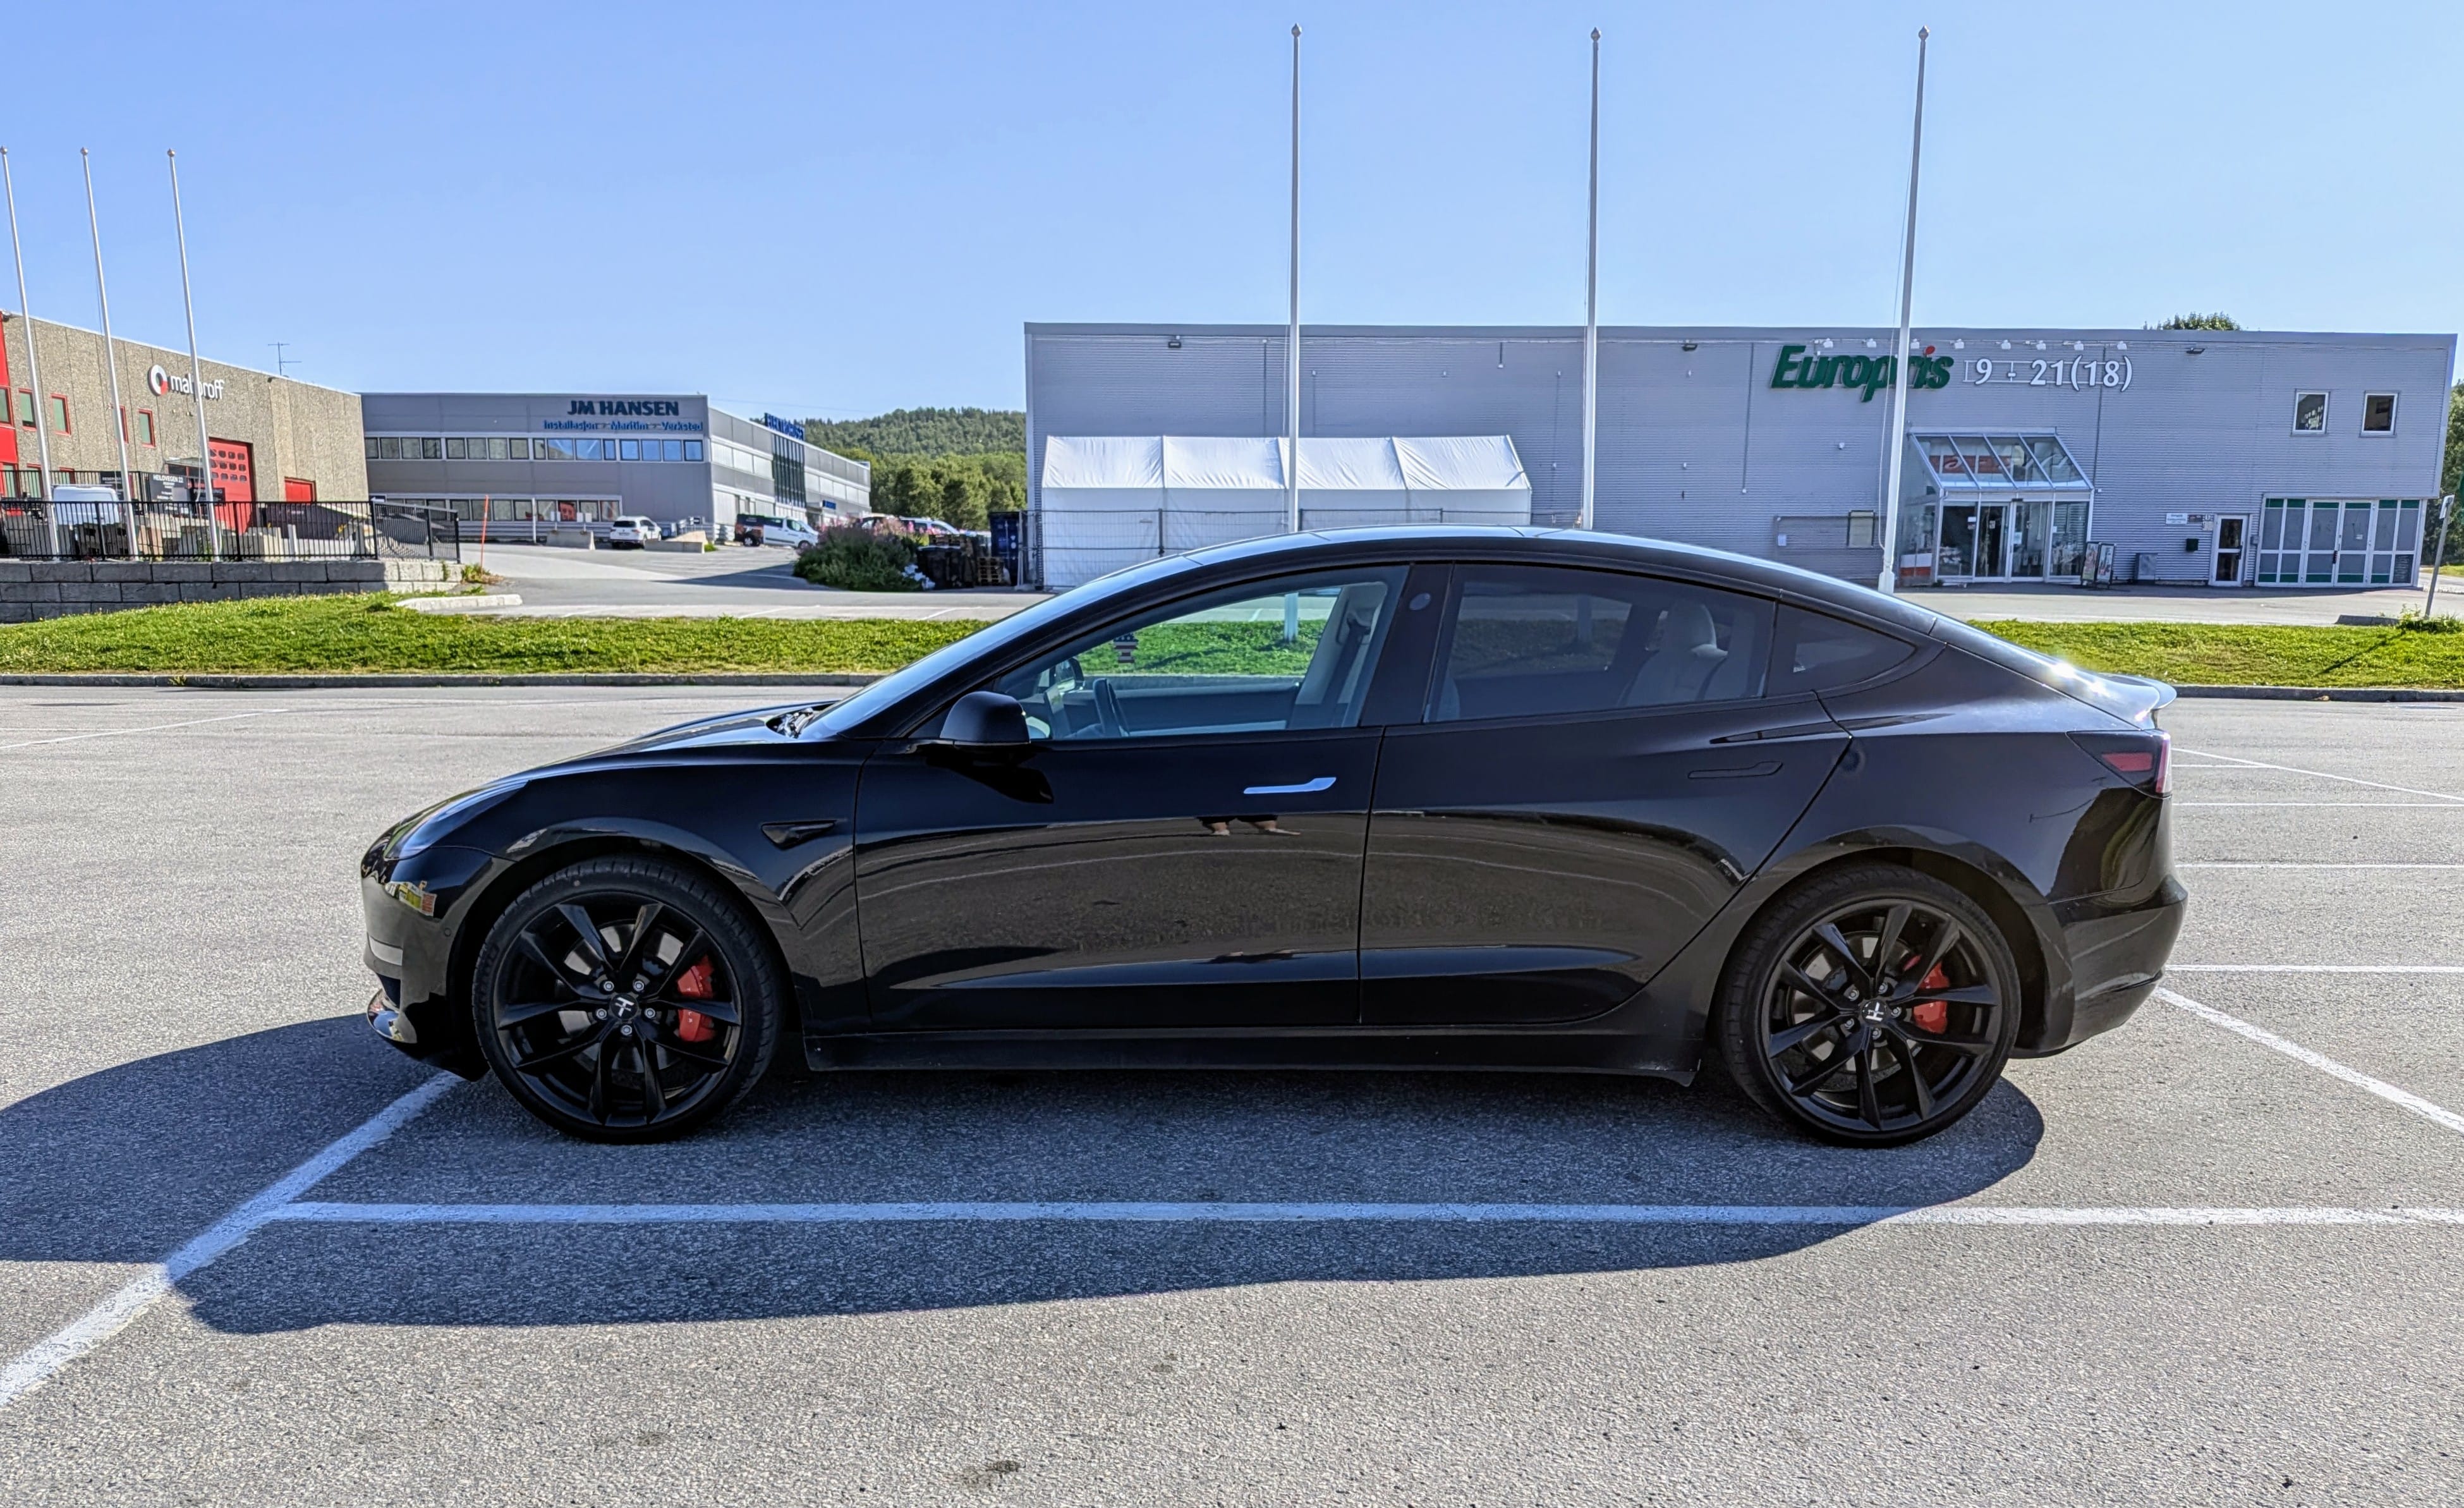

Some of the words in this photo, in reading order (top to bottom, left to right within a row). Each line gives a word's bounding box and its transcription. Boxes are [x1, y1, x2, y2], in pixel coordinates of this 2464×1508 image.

[1975, 358, 1992, 386] 9
[2030, 354, 2133, 392] 21(18)
[567, 400, 595, 415] JM
[600, 401, 679, 417] HANSEN
[543, 419, 598, 432] Installasjon
[610, 420, 649, 430] Maritim
[661, 421, 703, 431] Verksted
